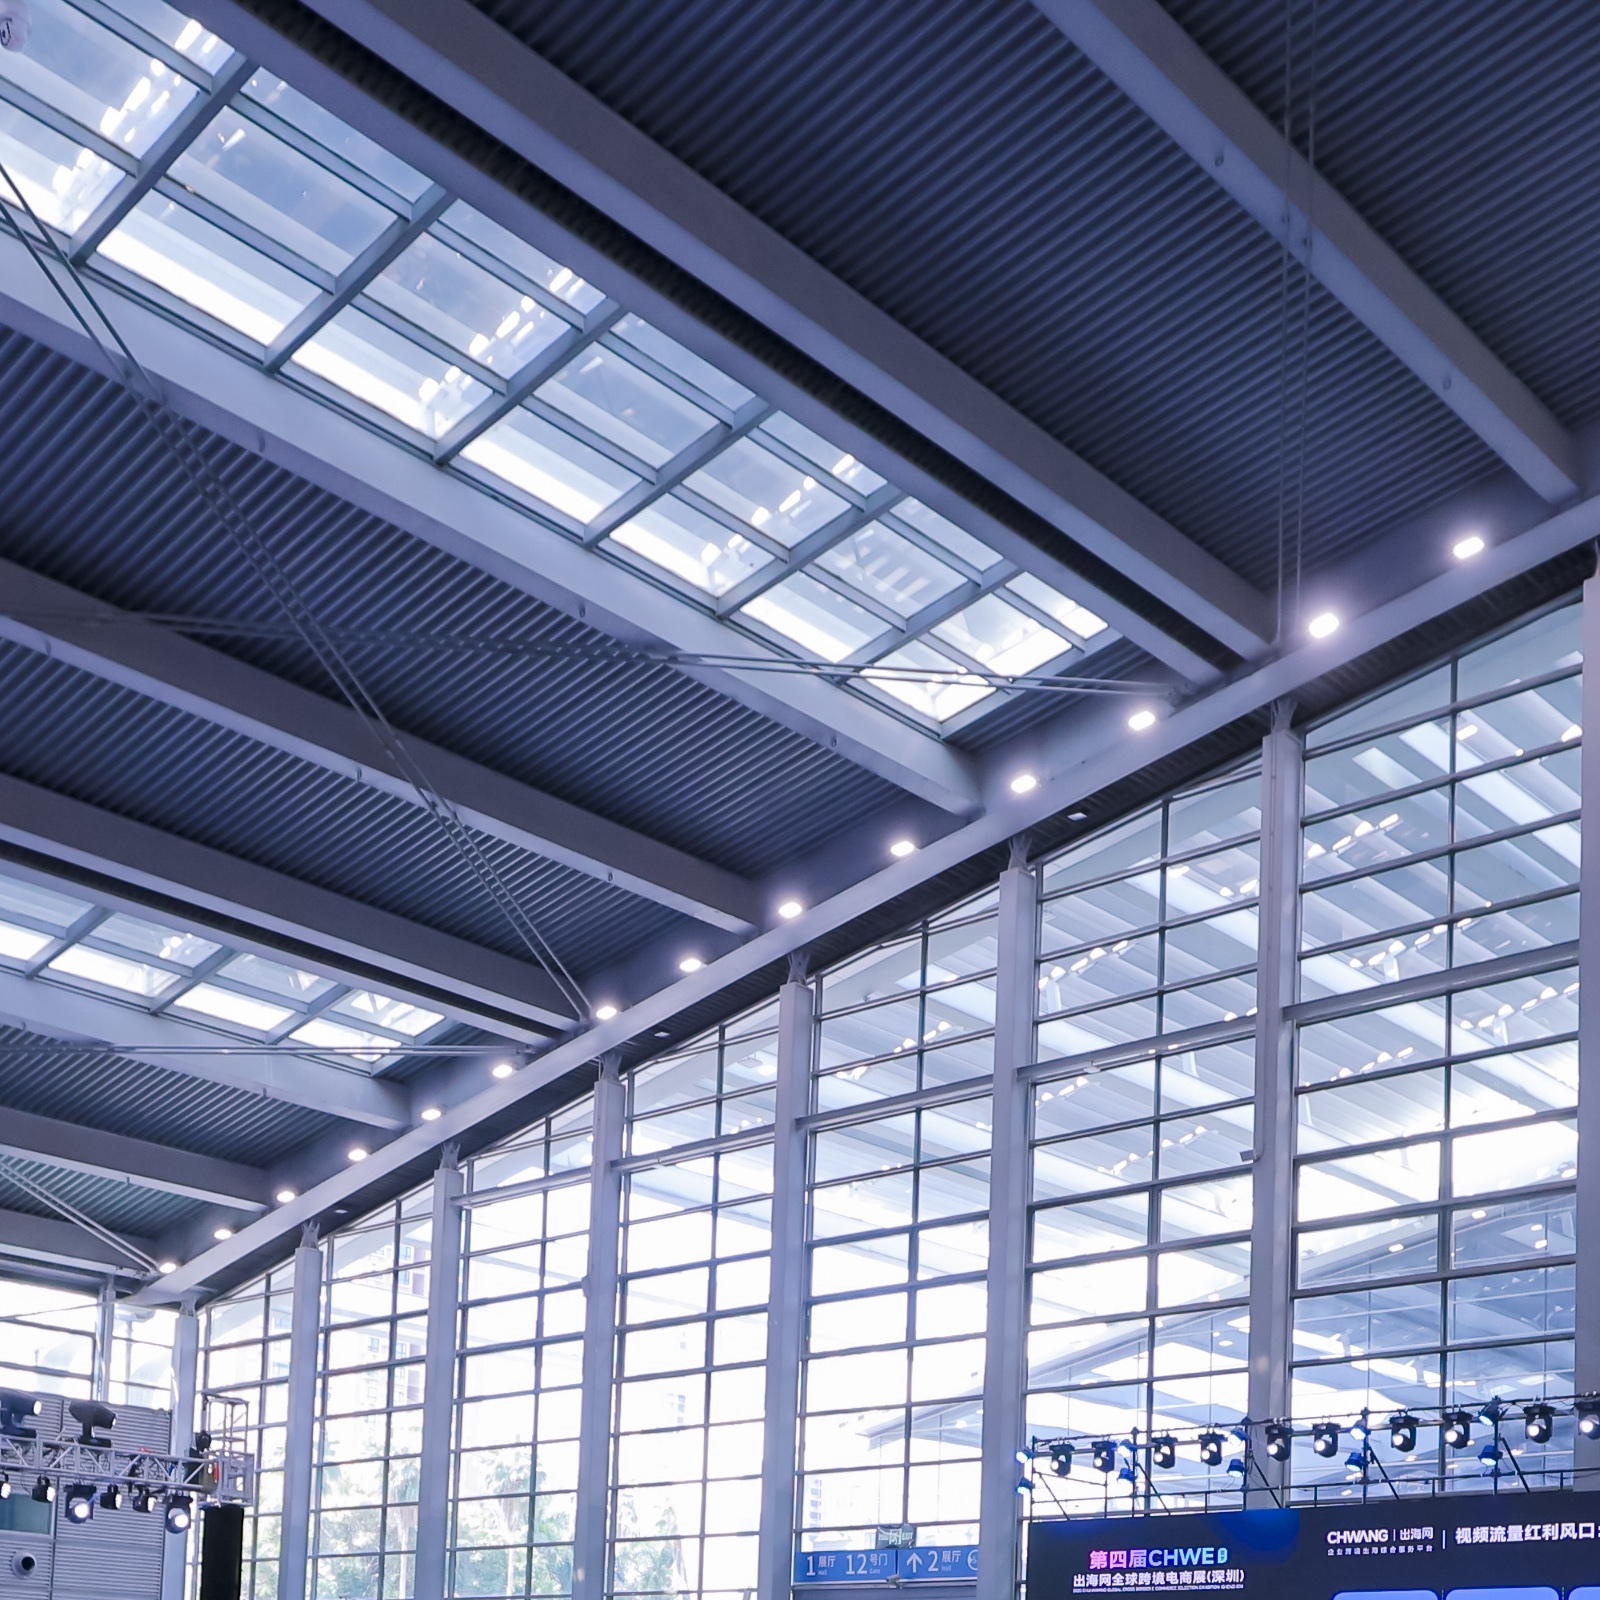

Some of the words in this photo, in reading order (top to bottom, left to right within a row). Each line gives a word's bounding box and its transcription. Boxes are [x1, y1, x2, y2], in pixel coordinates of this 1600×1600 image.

[1327, 1528, 1388, 1544] CHWANG
[1400, 1527, 1433, 1540] 出海网
[806, 1556, 815, 1576] 1
[818, 1556, 836, 1567] 展厅
[846, 1554, 867, 1575] 12
[869, 1553, 888, 1566] 号门
[928, 1551, 938, 1572] 2
[942, 1551, 961, 1563] 展厅
[1090, 1547, 1214, 1569] 第四届CHWE
[1073, 1569, 1245, 1588] 出海网全球跨境电商展(深圳)
